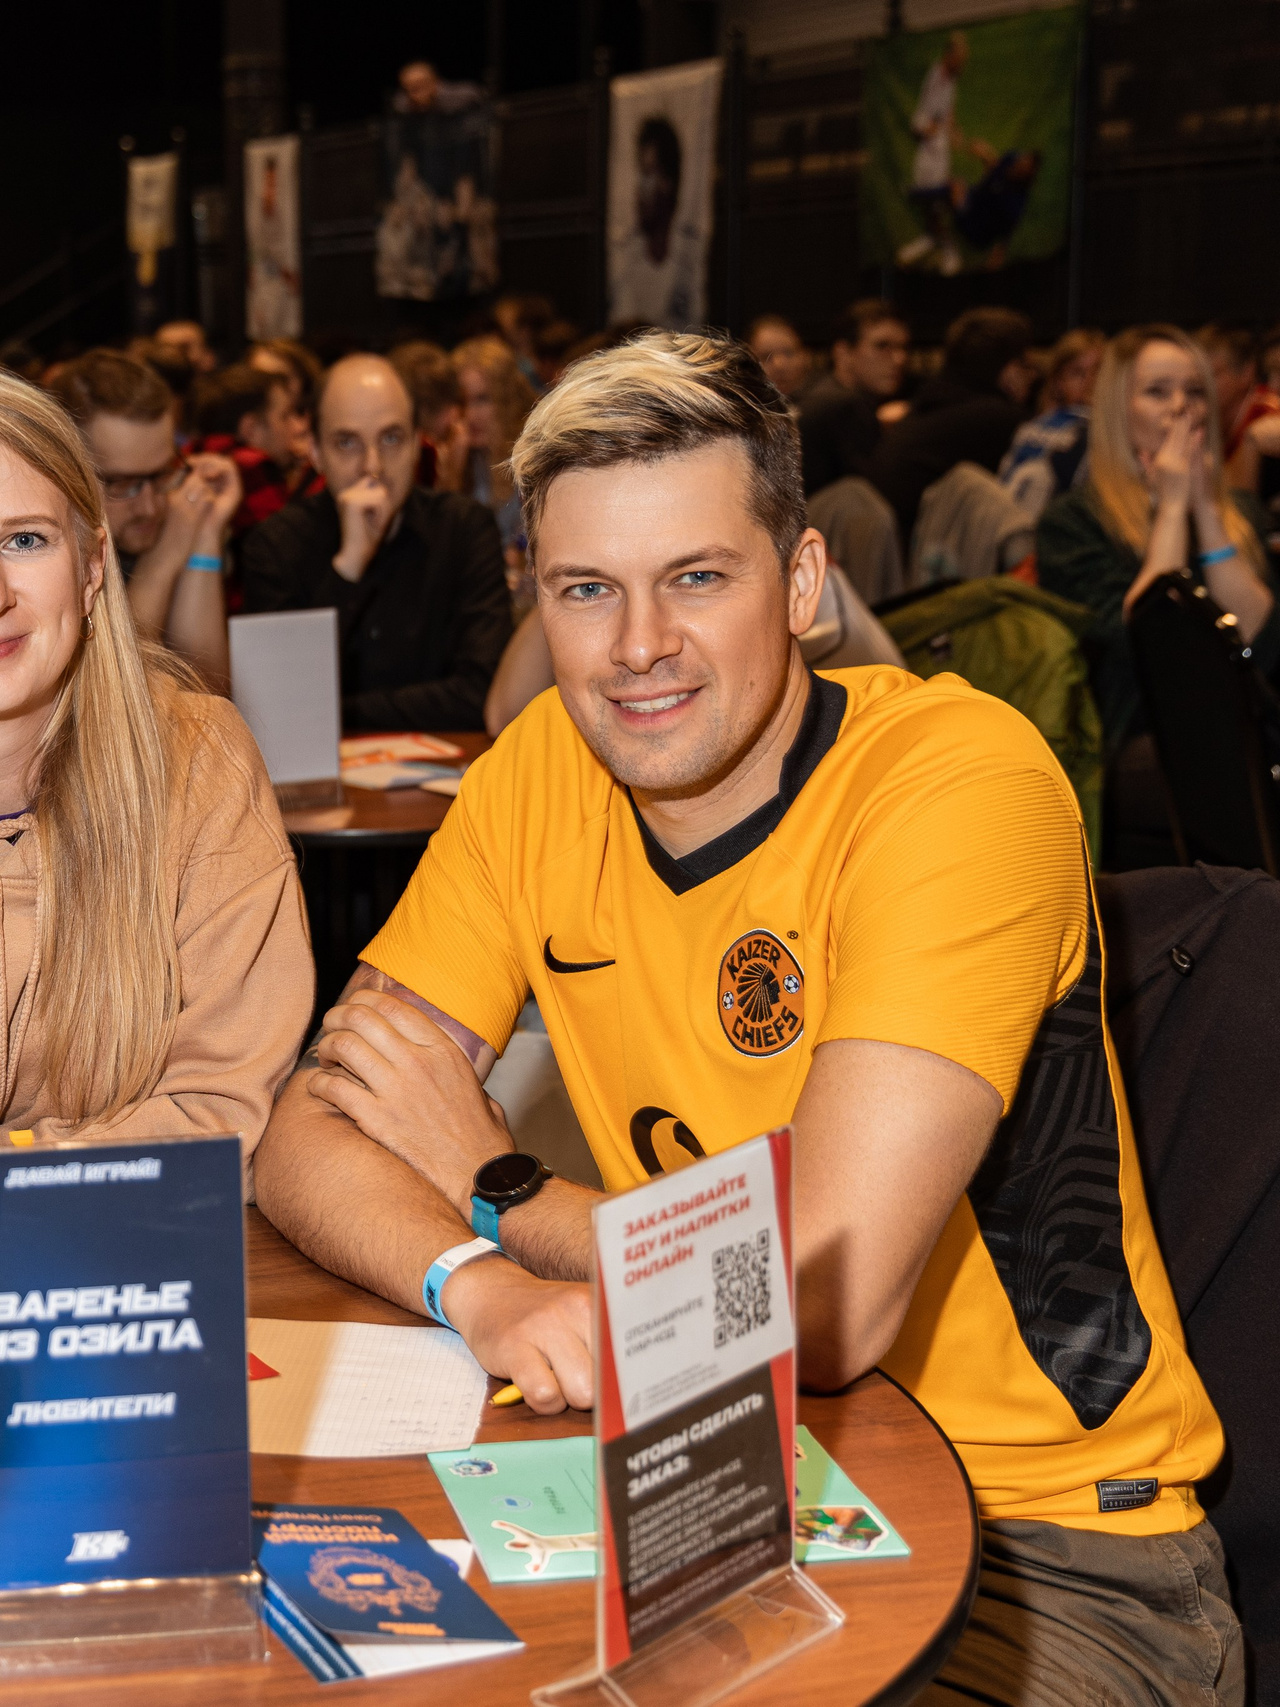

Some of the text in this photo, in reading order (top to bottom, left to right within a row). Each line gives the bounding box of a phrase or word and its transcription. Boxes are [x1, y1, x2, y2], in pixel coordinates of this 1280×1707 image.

[726, 939, 781, 982] KAIZER
[732, 1005, 799, 1048] CHIEFS
[4, 1162, 82, 1188] ДАВАЙ
[624, 1173, 746, 1238] ЗАКАЗЫВАЙТЕ
[624, 1195, 751, 1265] ЕДУ И НАПИТКИ
[624, 1244, 694, 1287] ОНЛАЙН
[48, 1317, 203, 1359] ОЗИЛА
[6, 1392, 176, 1427] ЛЮБИТЕЛИ
[627, 1393, 764, 1473] ЧТОБЫ СДЕЛАТЬ
[627, 1455, 690, 1499] ЗАКАЗ:
